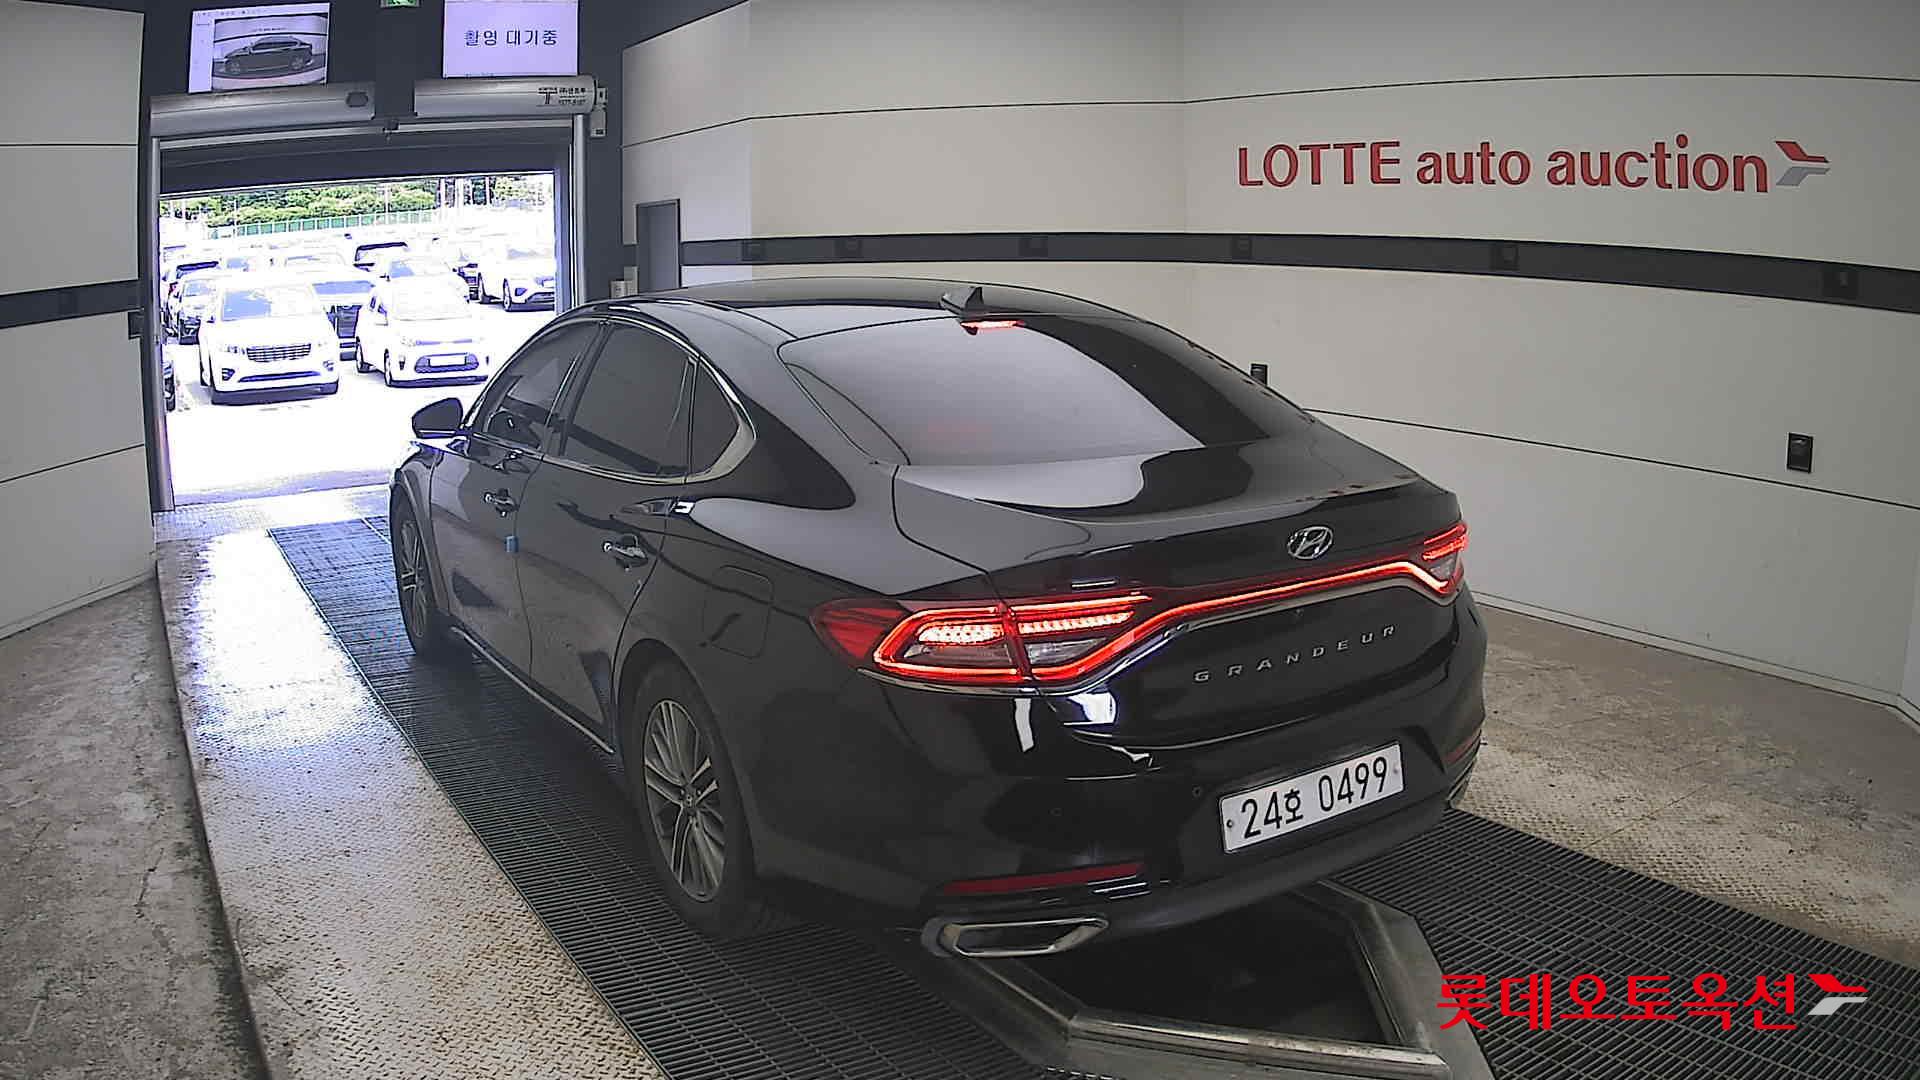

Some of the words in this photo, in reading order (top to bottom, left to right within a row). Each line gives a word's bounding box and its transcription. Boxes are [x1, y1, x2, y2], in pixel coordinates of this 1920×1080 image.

[506, 29, 558, 46] 대기중
[1238, 140, 1401, 187] LOTTE
[1416, 141, 1531, 186] auto
[1546, 133, 1769, 193] auction
[1193, 624, 1397, 683] GRANDEUR
[1240, 787, 1304, 840] 24호
[1318, 755, 1388, 812] 0499
